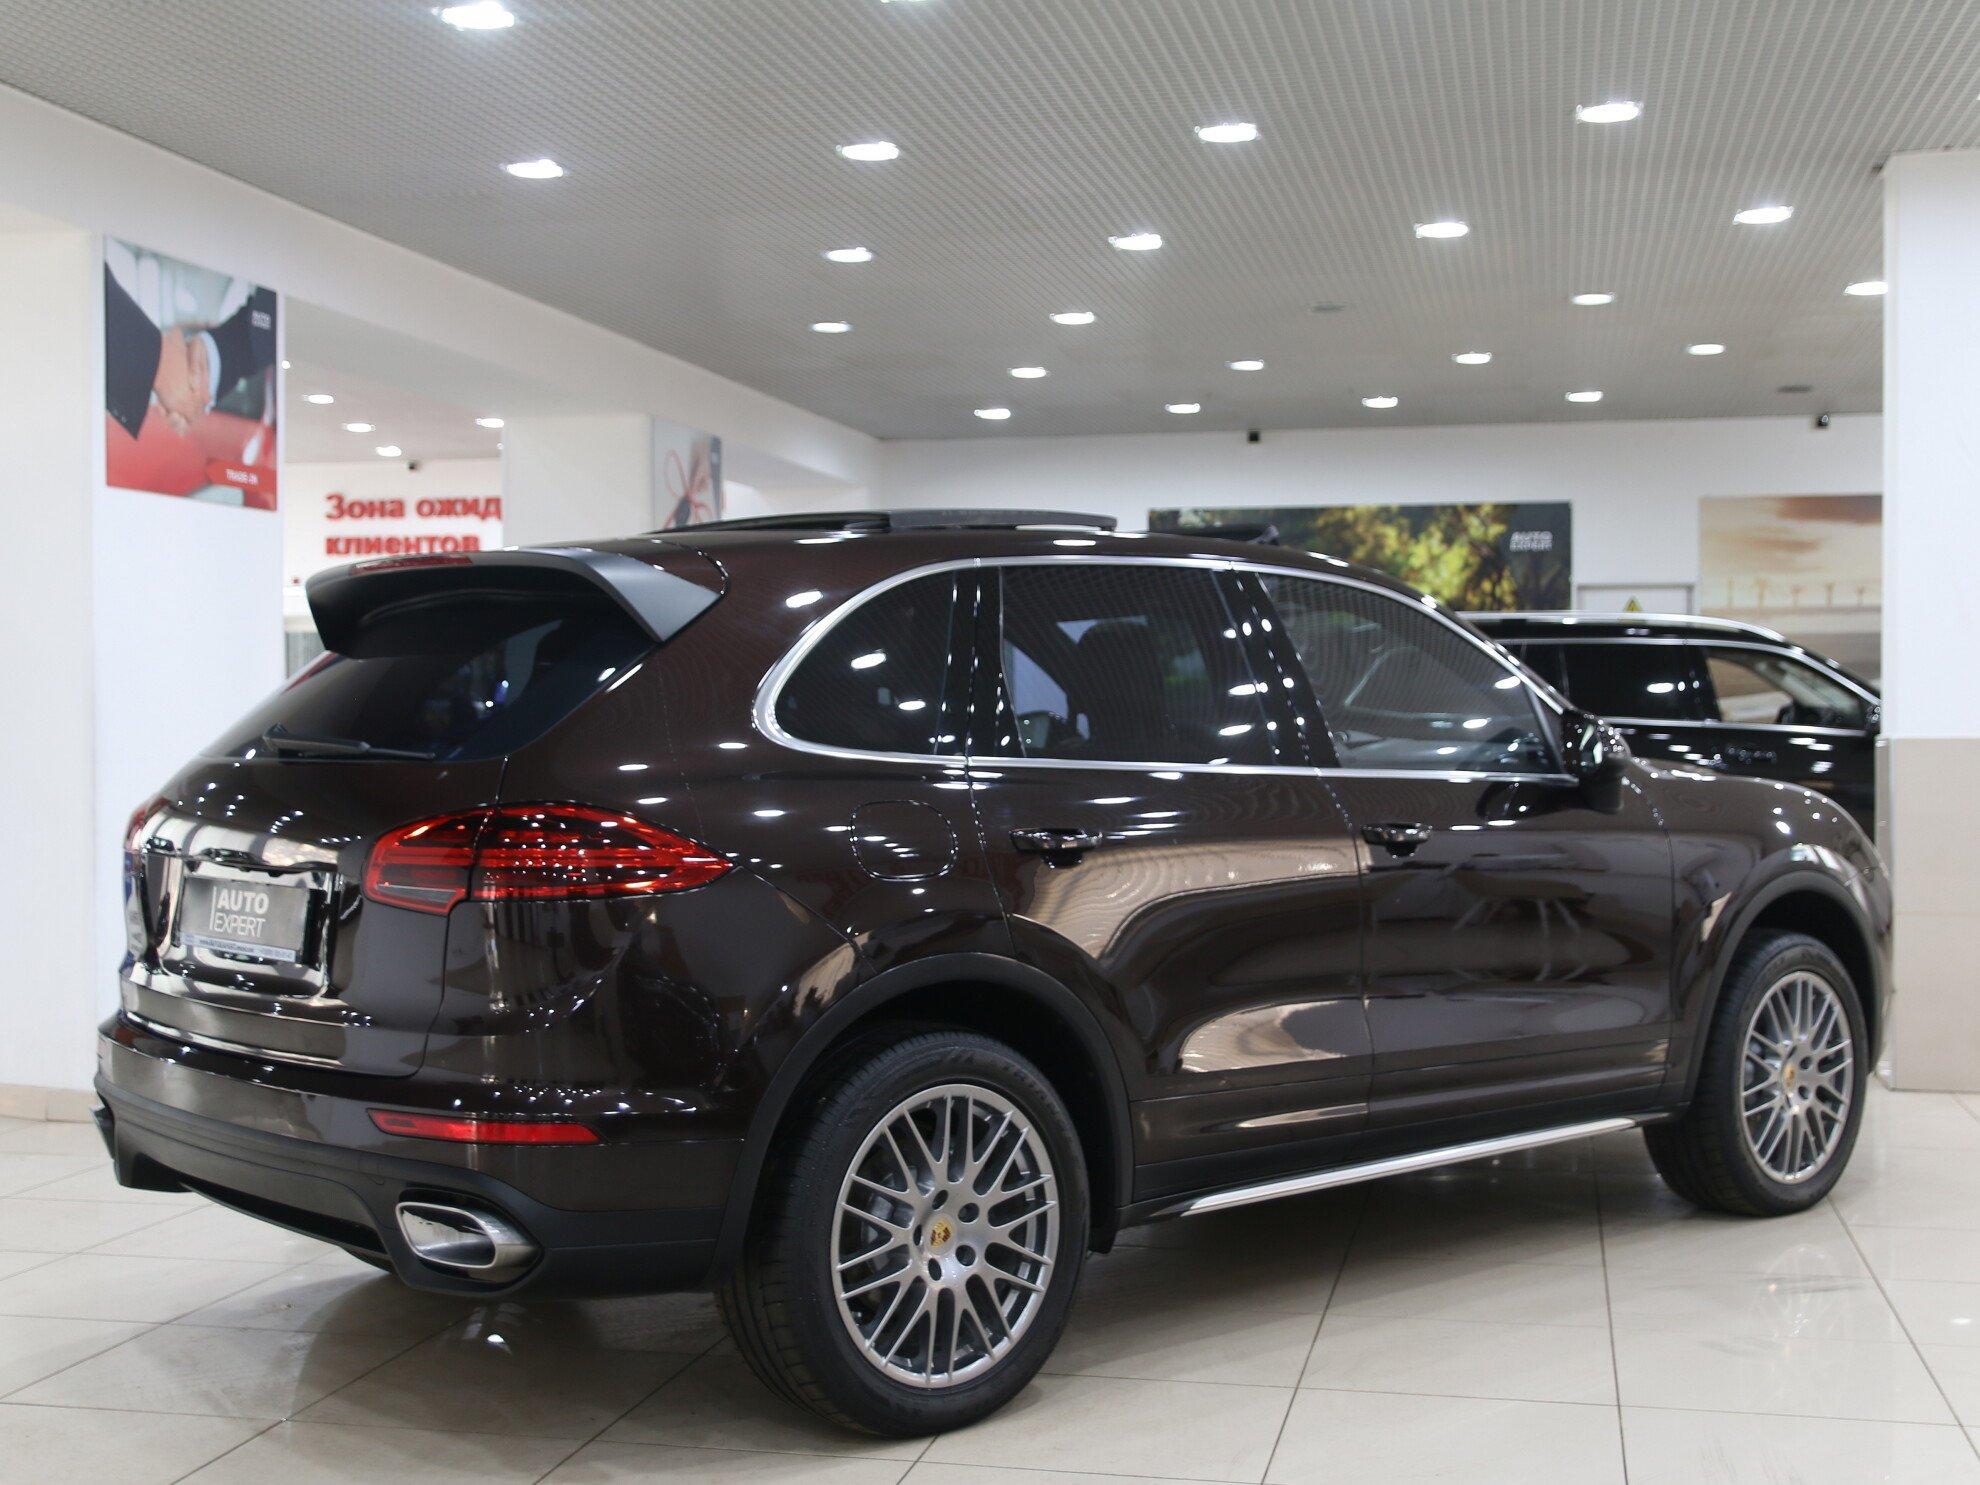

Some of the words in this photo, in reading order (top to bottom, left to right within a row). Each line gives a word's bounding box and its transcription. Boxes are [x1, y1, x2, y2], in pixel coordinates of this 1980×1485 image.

[325, 493, 405, 520] Зона
[325, 536, 480, 554] клиентов
[217, 888, 270, 915] AUTO
[213, 911, 267, 938] EXPERT
